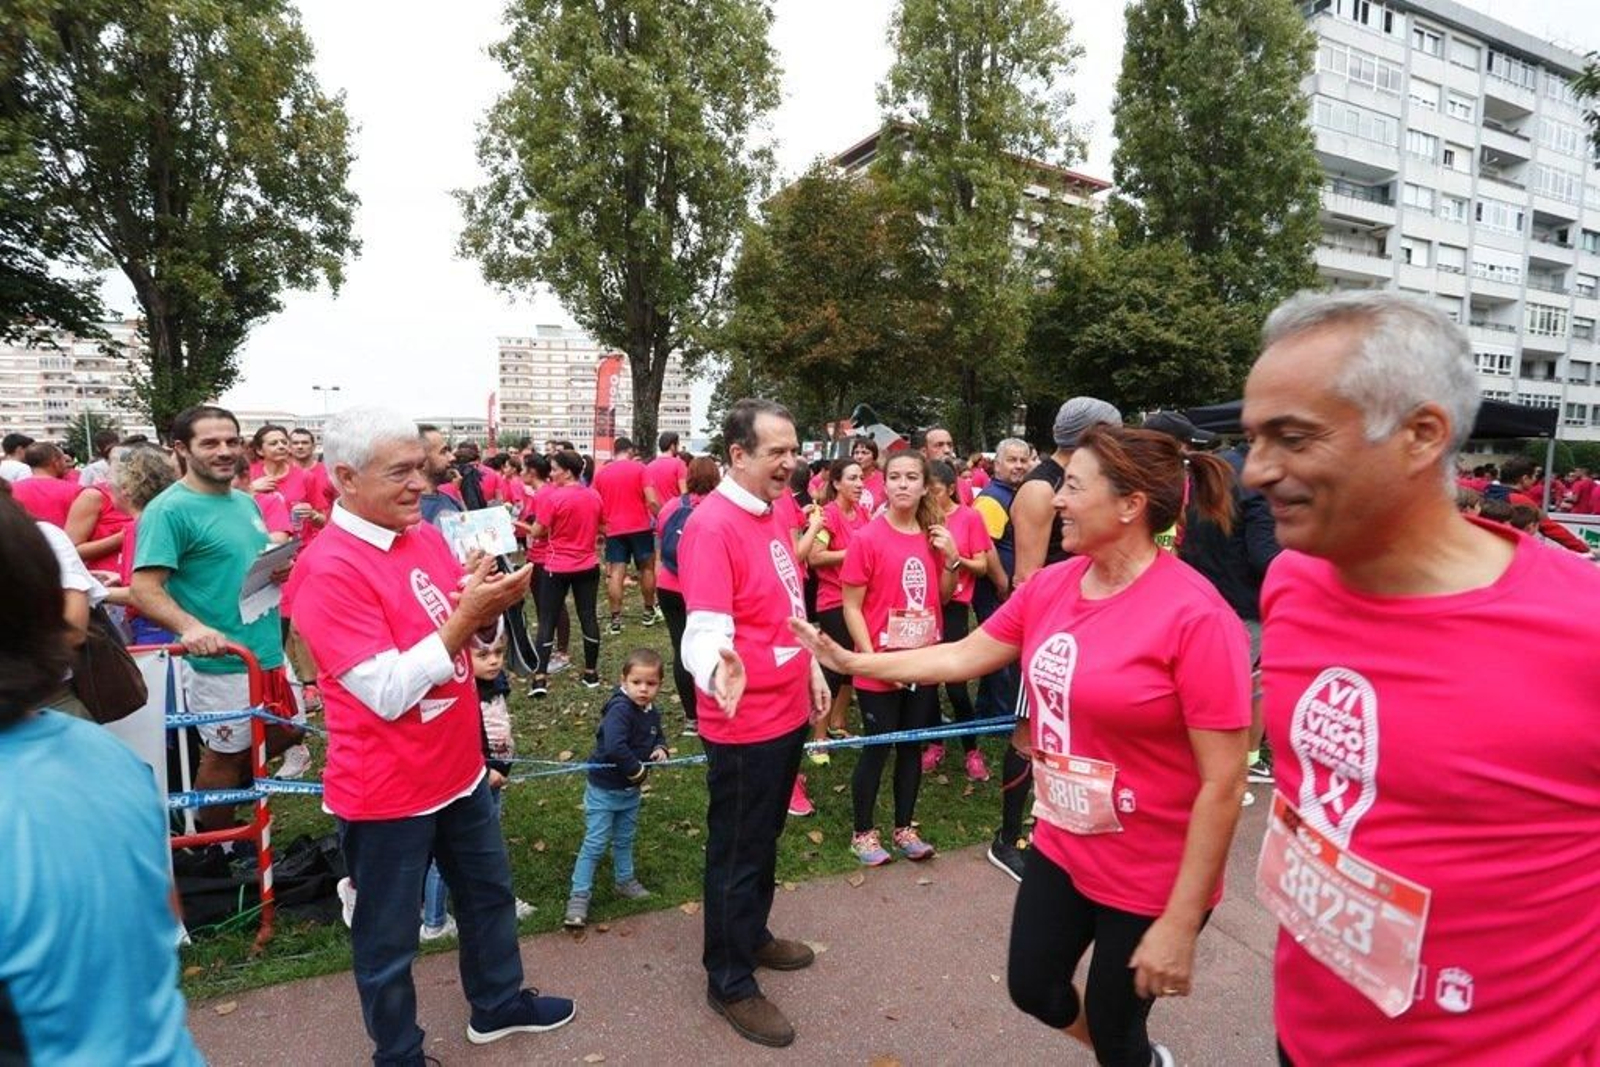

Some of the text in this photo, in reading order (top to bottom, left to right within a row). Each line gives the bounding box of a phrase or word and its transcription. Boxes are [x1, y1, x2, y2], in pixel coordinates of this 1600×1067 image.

[1328, 681, 1361, 712] VI
[1306, 711, 1364, 752] VIGO
[1045, 775, 1090, 815] 3816
[1280, 847, 1375, 955] 3823
